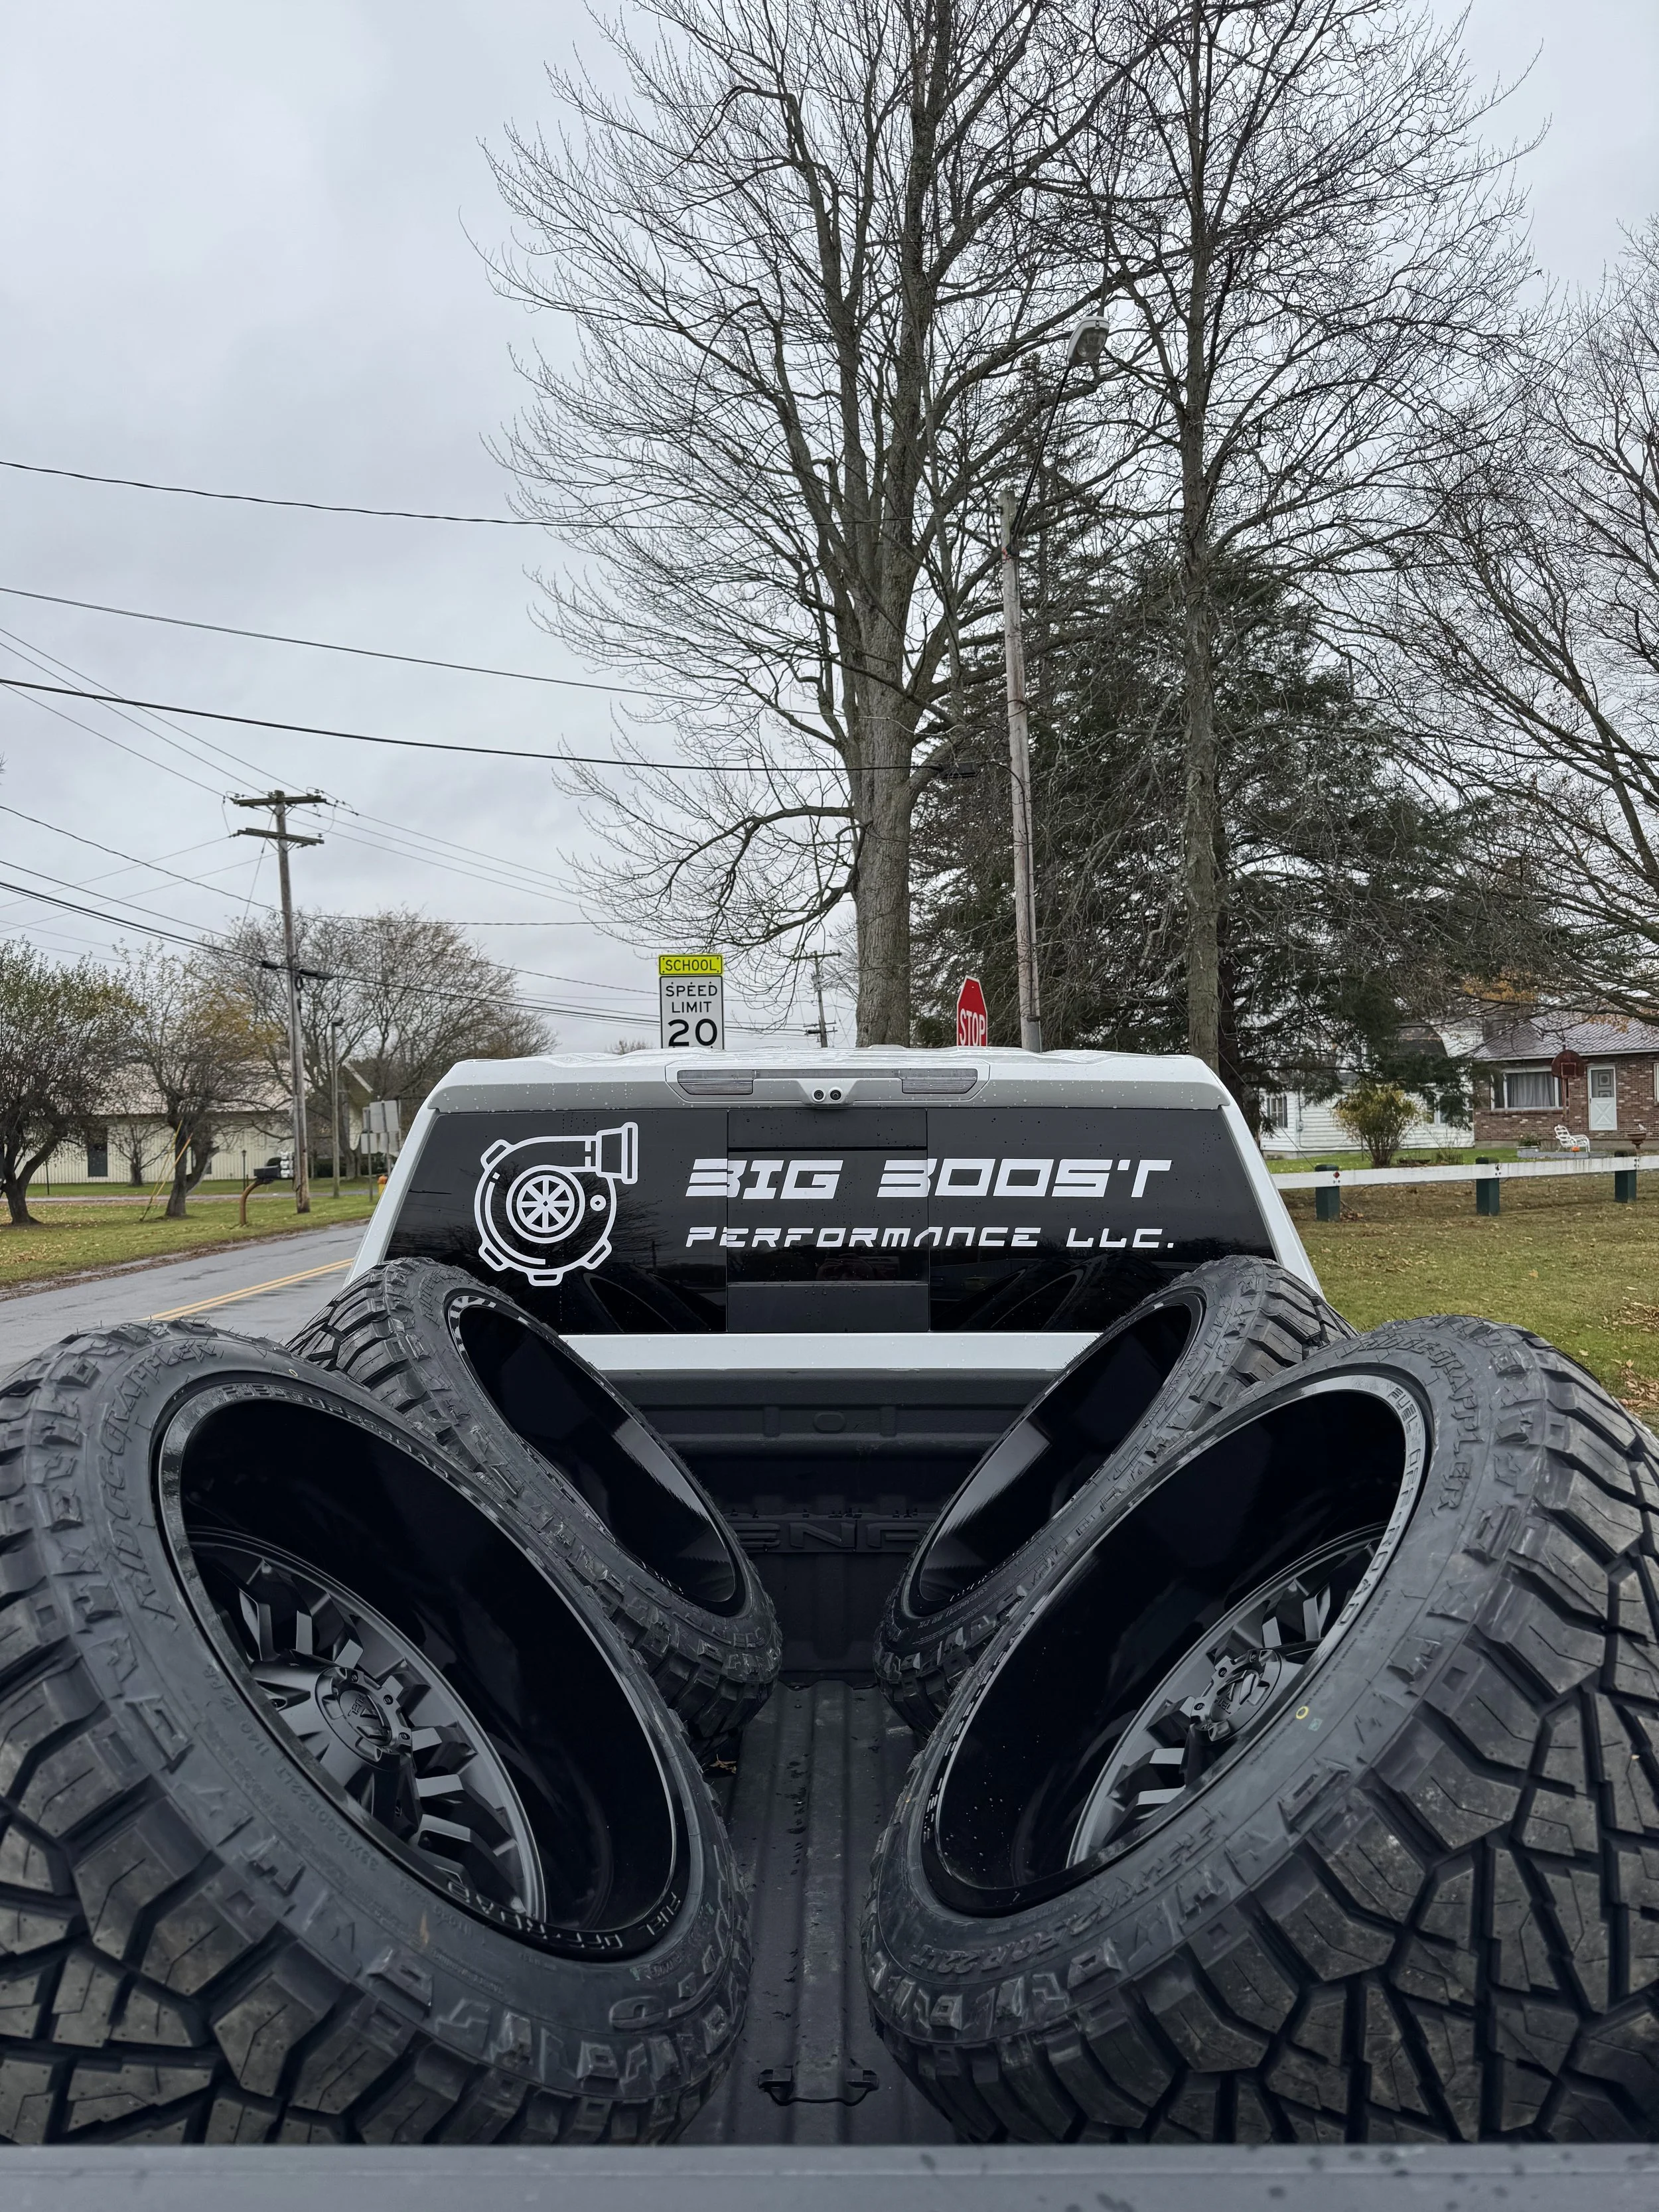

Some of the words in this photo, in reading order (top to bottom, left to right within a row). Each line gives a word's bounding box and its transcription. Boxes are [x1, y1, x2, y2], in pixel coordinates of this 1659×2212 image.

[665, 959, 717, 971] SCHOOL
[666, 985, 717, 996] SPEED
[672, 1001, 711, 1013] LIMIT
[668, 1018, 717, 1047] 20
[959, 1007, 985, 1047] STOP
[685, 1158, 843, 1199] BIG
[877, 1158, 1173, 1198] BOOST
[685, 1226, 1041, 1248] PERFORMANCE
[1066, 1228, 1175, 1248] LLC.
[1388, 1386, 1418, 1435] FUEL
[1336, 1448, 1421, 1626] OFF-ROAD
[447, 1880, 624, 1950] OFF-ROAD
[640, 1891, 682, 1936] FUEL
